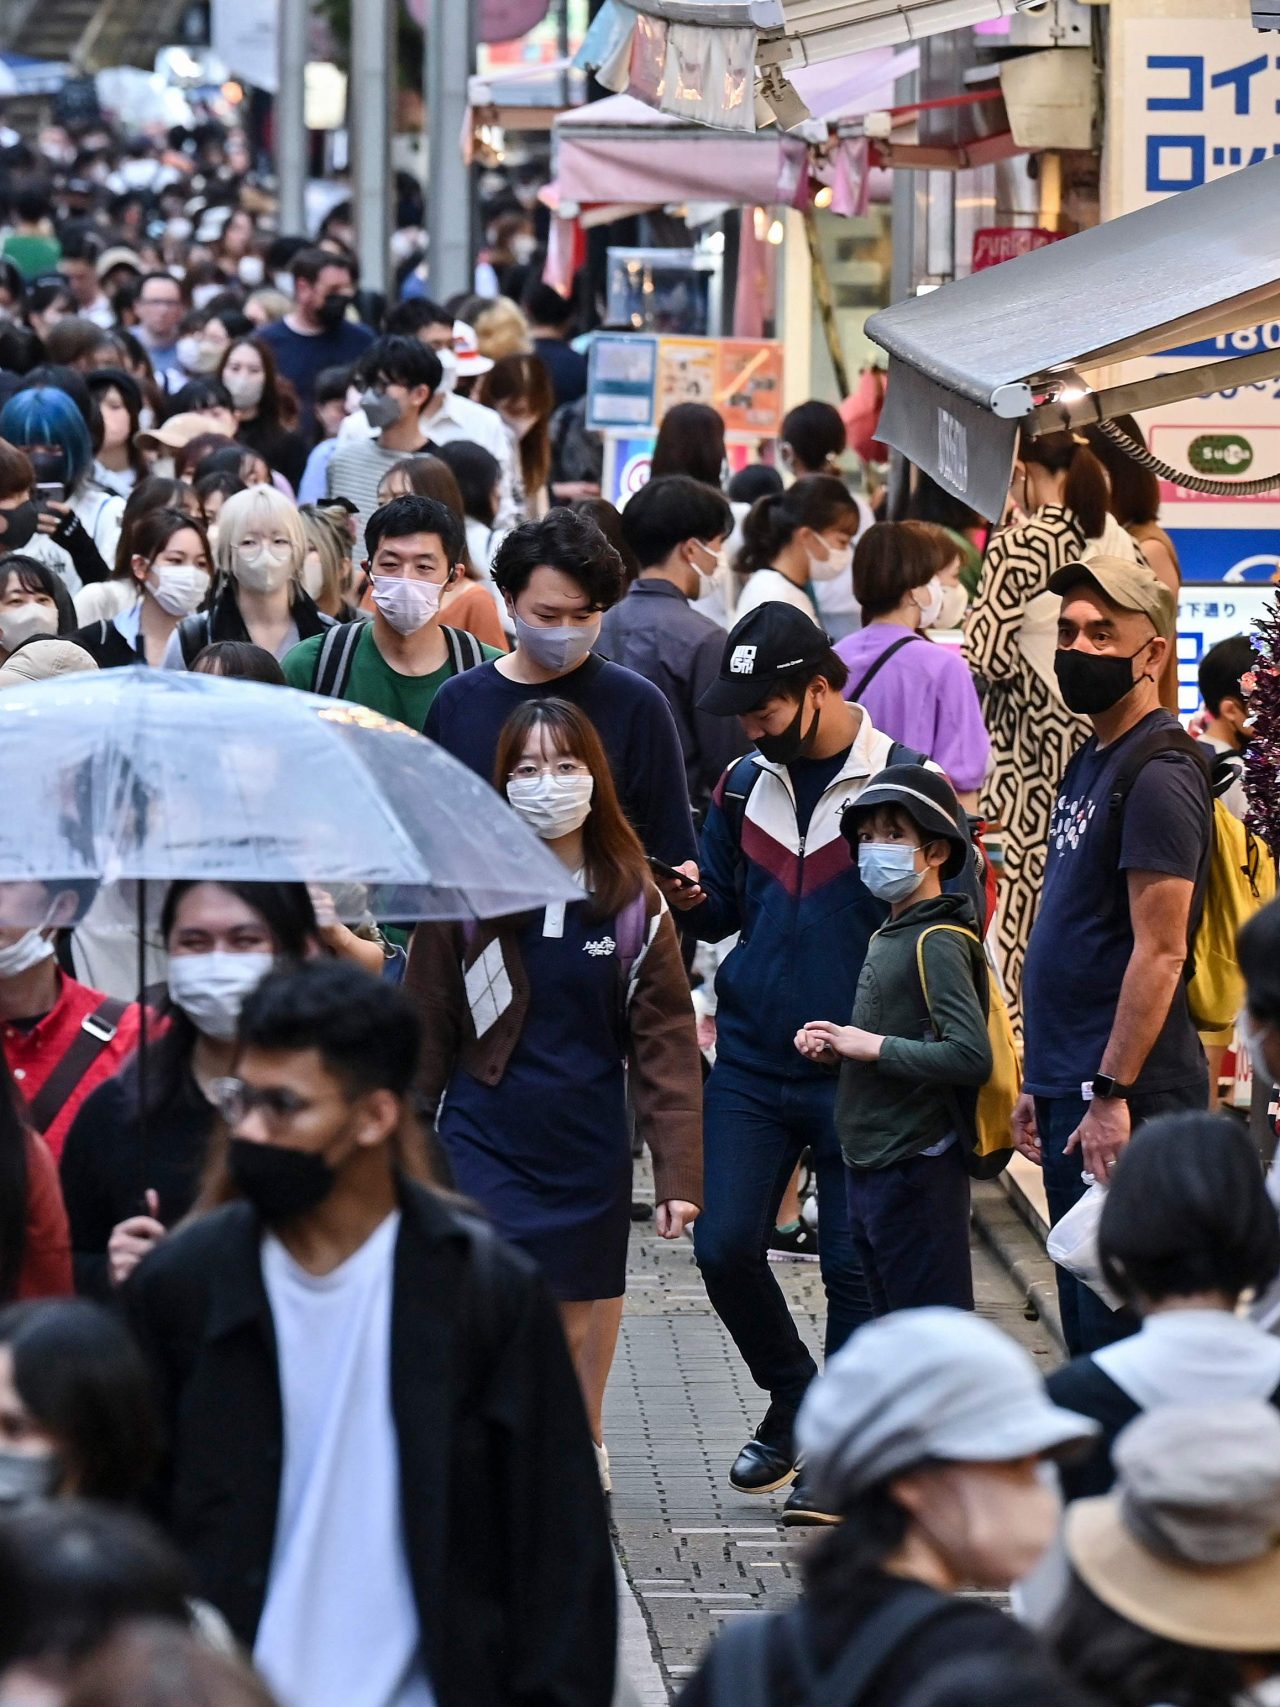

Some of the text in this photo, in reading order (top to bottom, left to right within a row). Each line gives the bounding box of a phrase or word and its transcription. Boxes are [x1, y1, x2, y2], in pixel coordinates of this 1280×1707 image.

[1146, 53, 1280, 116] コイ
[1146, 135, 1280, 191] ロッ
[1177, 602, 1236, 618] 下通り
